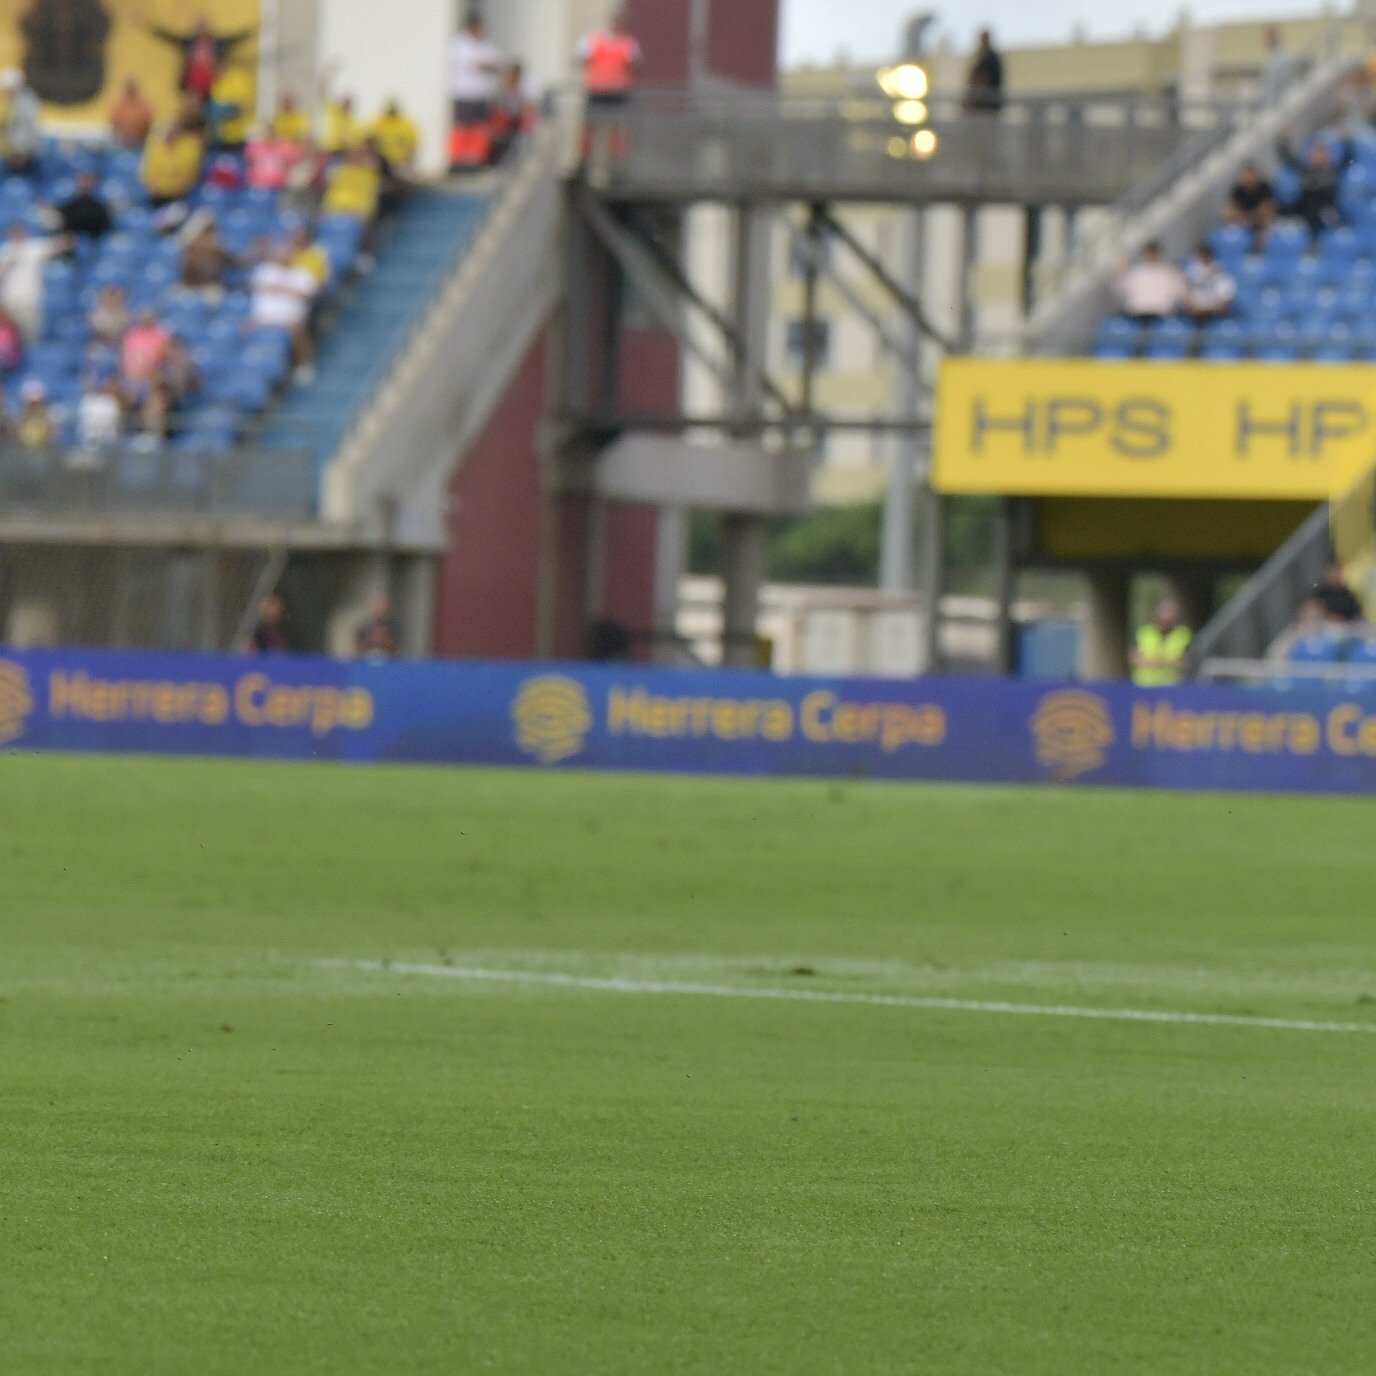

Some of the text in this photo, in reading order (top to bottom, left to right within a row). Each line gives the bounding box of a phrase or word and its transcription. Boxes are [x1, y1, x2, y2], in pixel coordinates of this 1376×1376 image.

[970, 396, 1172, 460] HPS
[48, 667, 374, 736] Herrera Cerpa
[607, 684, 946, 753] Herrera Cerpa
[1130, 700, 1320, 757] Herrera
